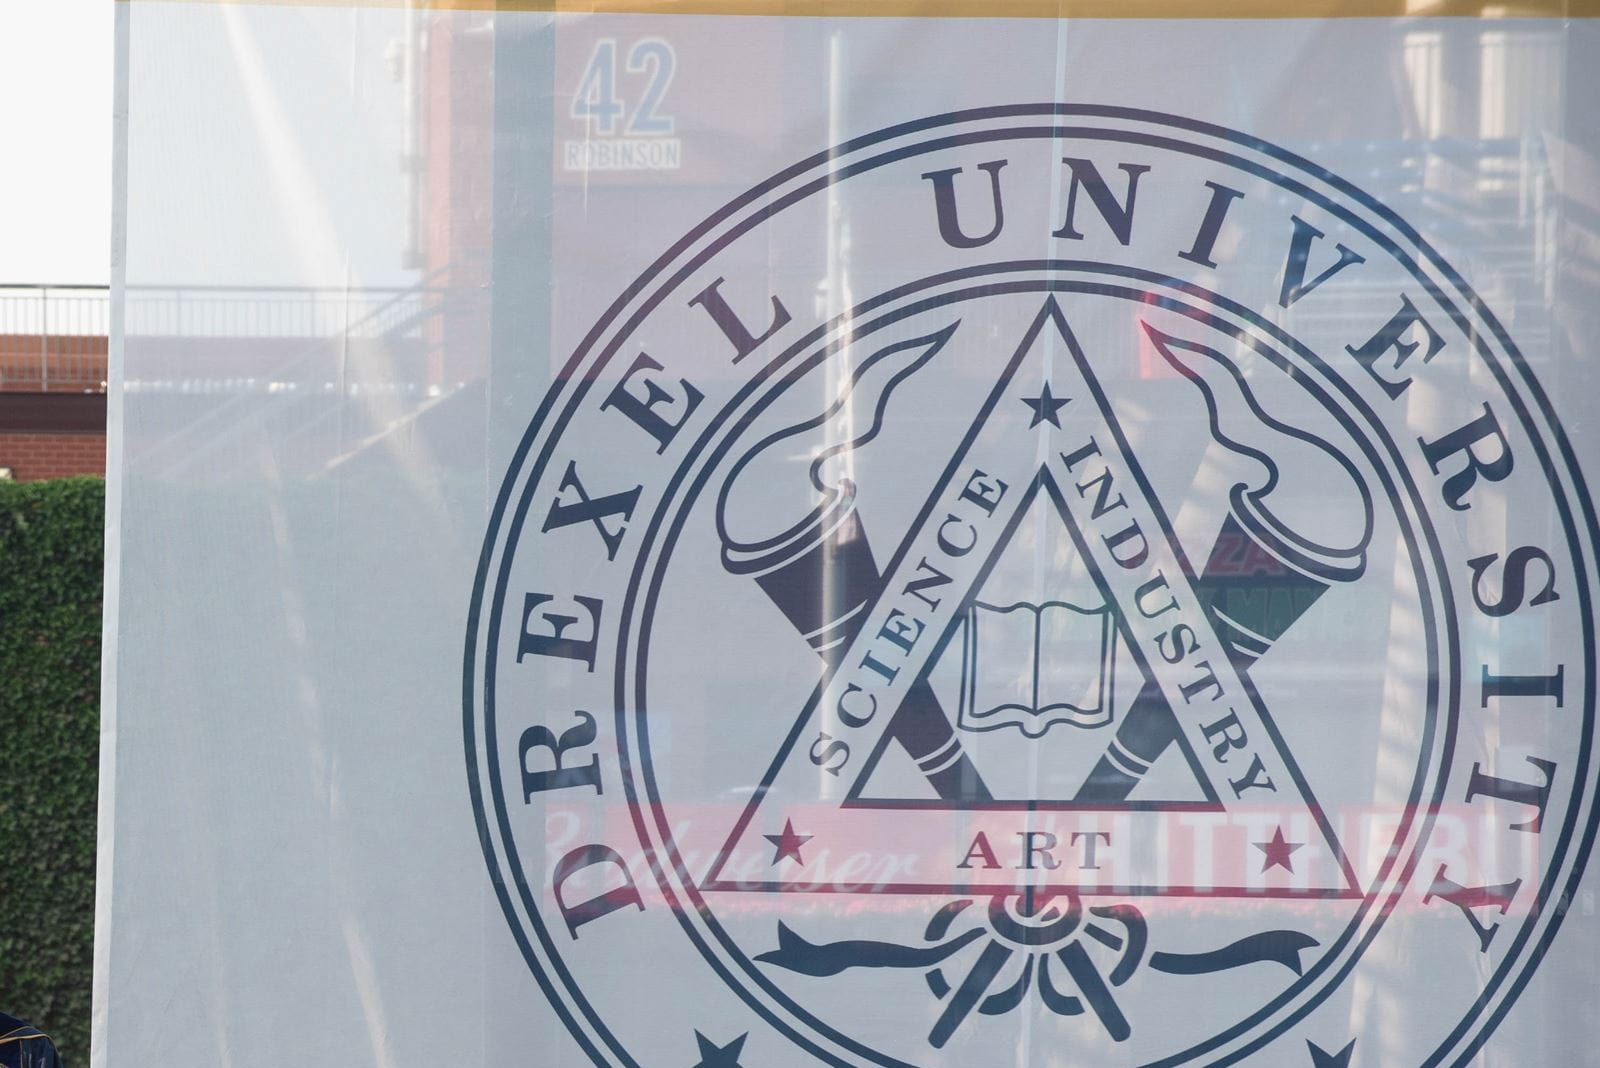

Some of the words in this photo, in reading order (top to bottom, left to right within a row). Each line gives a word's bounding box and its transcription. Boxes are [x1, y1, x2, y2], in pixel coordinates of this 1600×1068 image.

[566, 140, 679, 169] ROBINSON
[570, 37, 676, 136] 42
[516, 276, 793, 940] DREXEL
[921, 157, 1564, 953] UNIVERSITY
[809, 469, 1010, 777] SCIENCE
[1059, 435, 1277, 800] INDUSTRY
[957, 830, 1110, 871] ART
